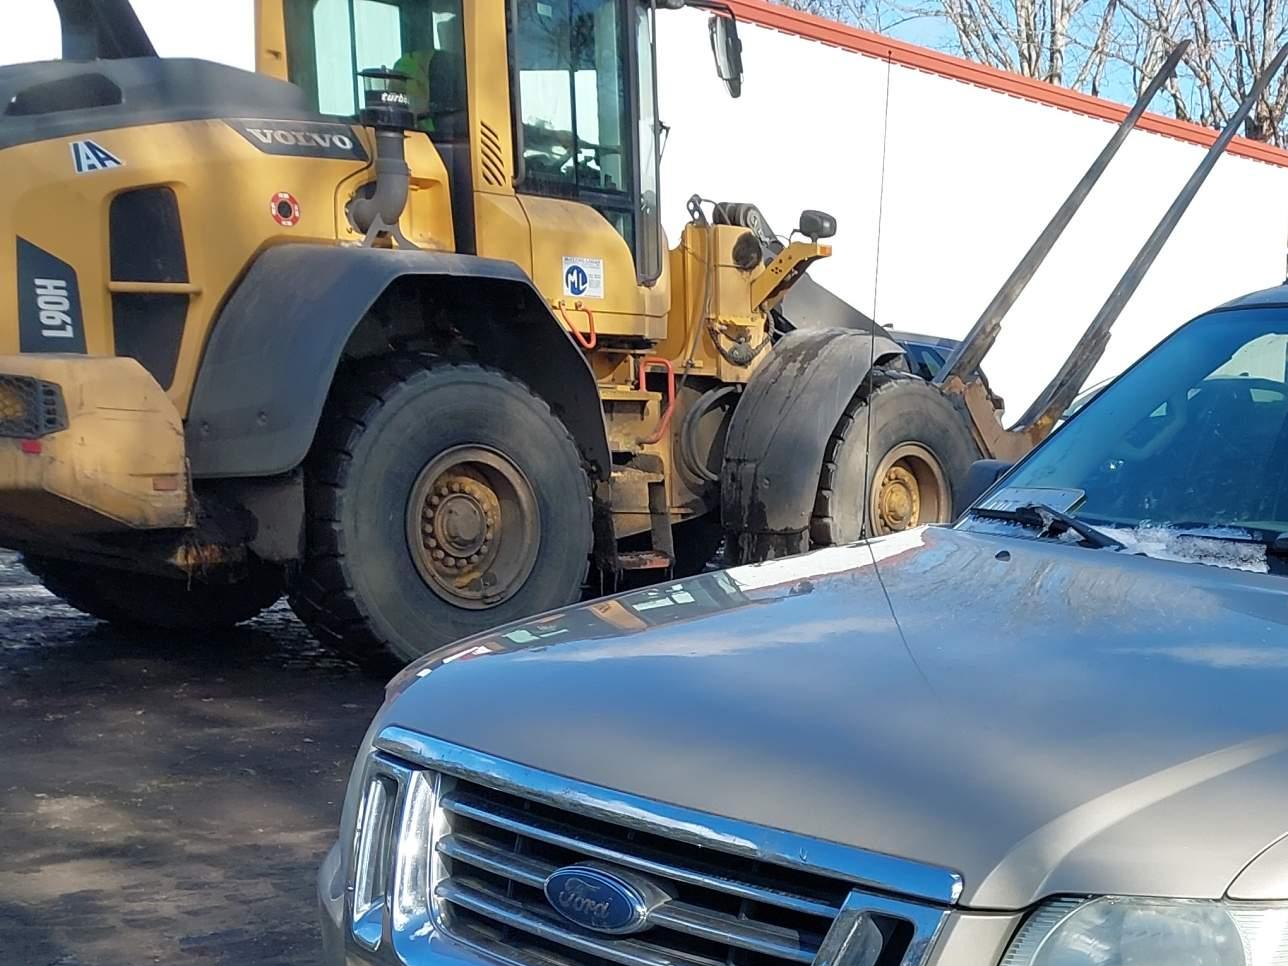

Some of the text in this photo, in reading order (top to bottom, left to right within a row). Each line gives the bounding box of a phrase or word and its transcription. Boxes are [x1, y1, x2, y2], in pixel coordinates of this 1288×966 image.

[245, 127, 353, 150] VOLVO
[34, 277, 75, 338] L90H
[559, 878, 613, 918] Ford
